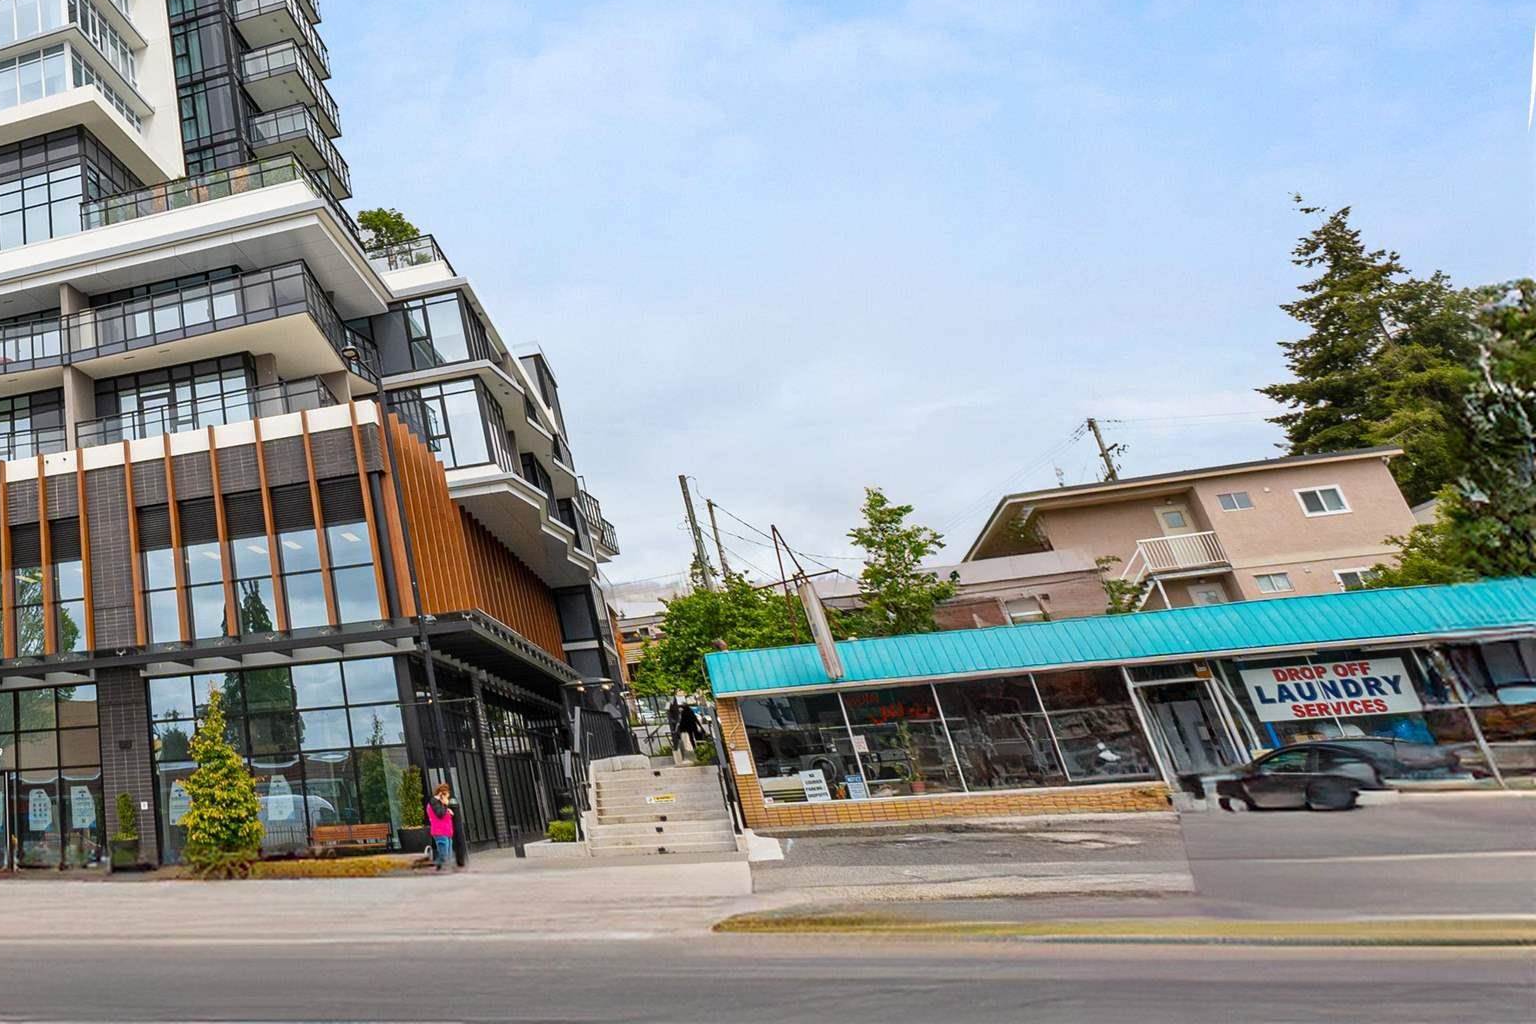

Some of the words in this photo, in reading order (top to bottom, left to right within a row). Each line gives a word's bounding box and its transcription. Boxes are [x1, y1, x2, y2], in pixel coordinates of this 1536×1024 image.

[1272, 665, 1327, 683] DROP
[1333, 662, 1372, 678] OFF
[1254, 674, 1403, 705] LAUNDRY
[1291, 698, 1388, 718] SERVICES
